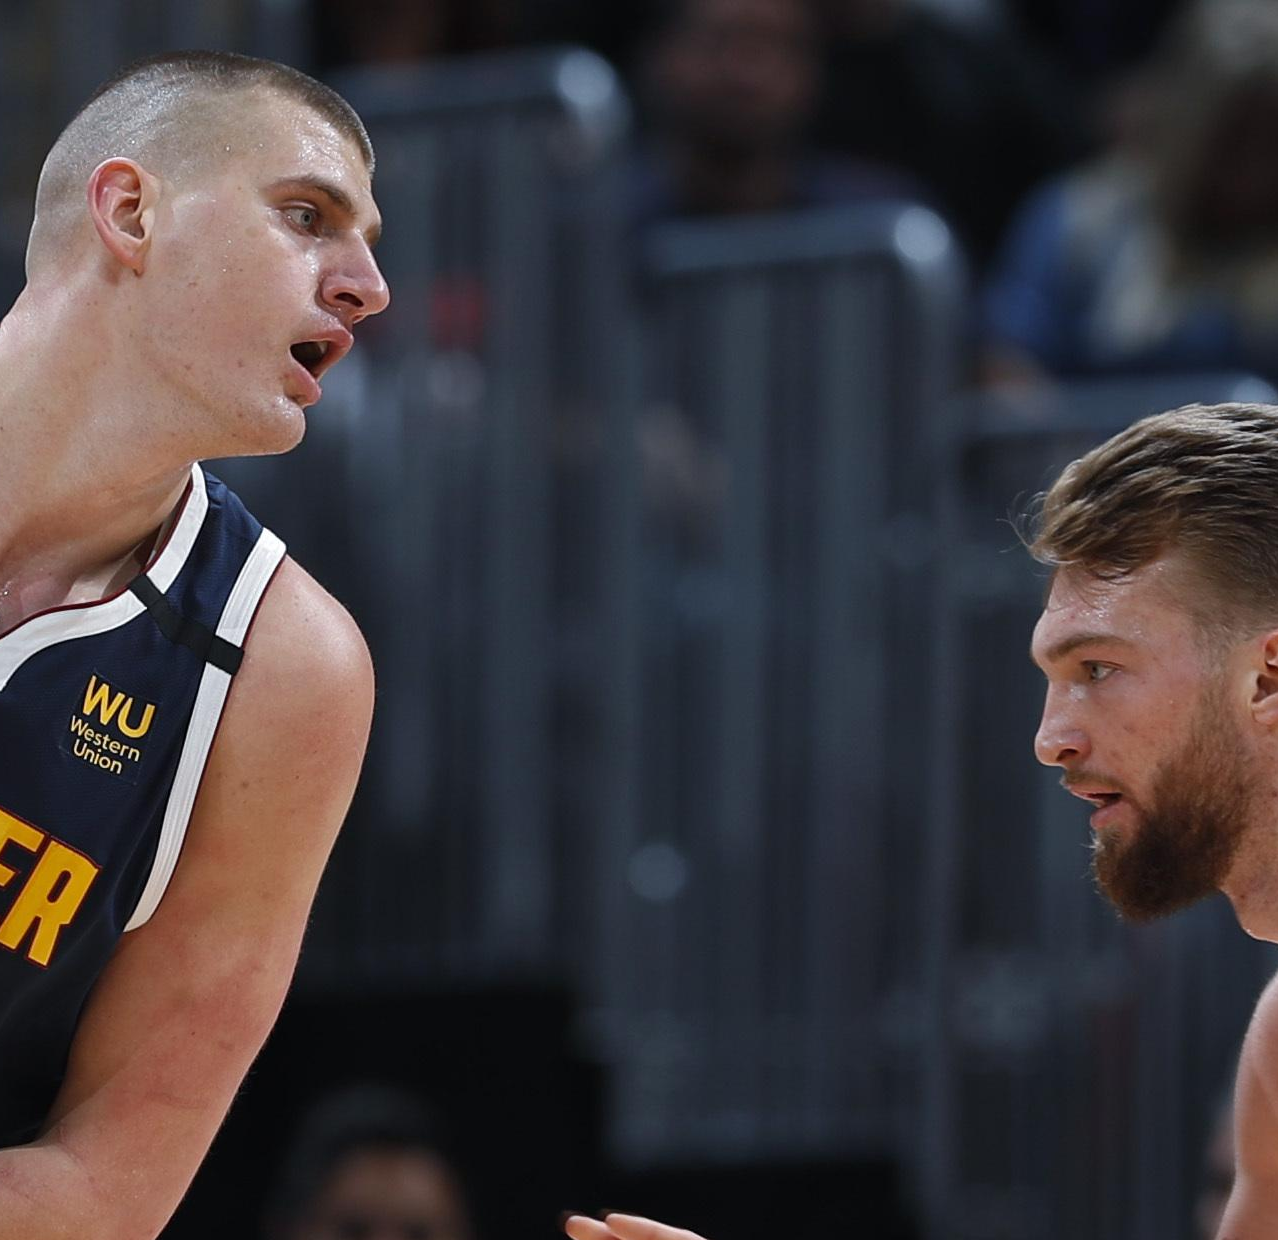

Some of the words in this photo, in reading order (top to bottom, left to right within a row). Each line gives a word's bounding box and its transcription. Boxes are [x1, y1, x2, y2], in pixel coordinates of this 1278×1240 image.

[82, 674, 156, 738] WU
[70, 715, 140, 762] Western
[73, 738, 123, 775] Union
